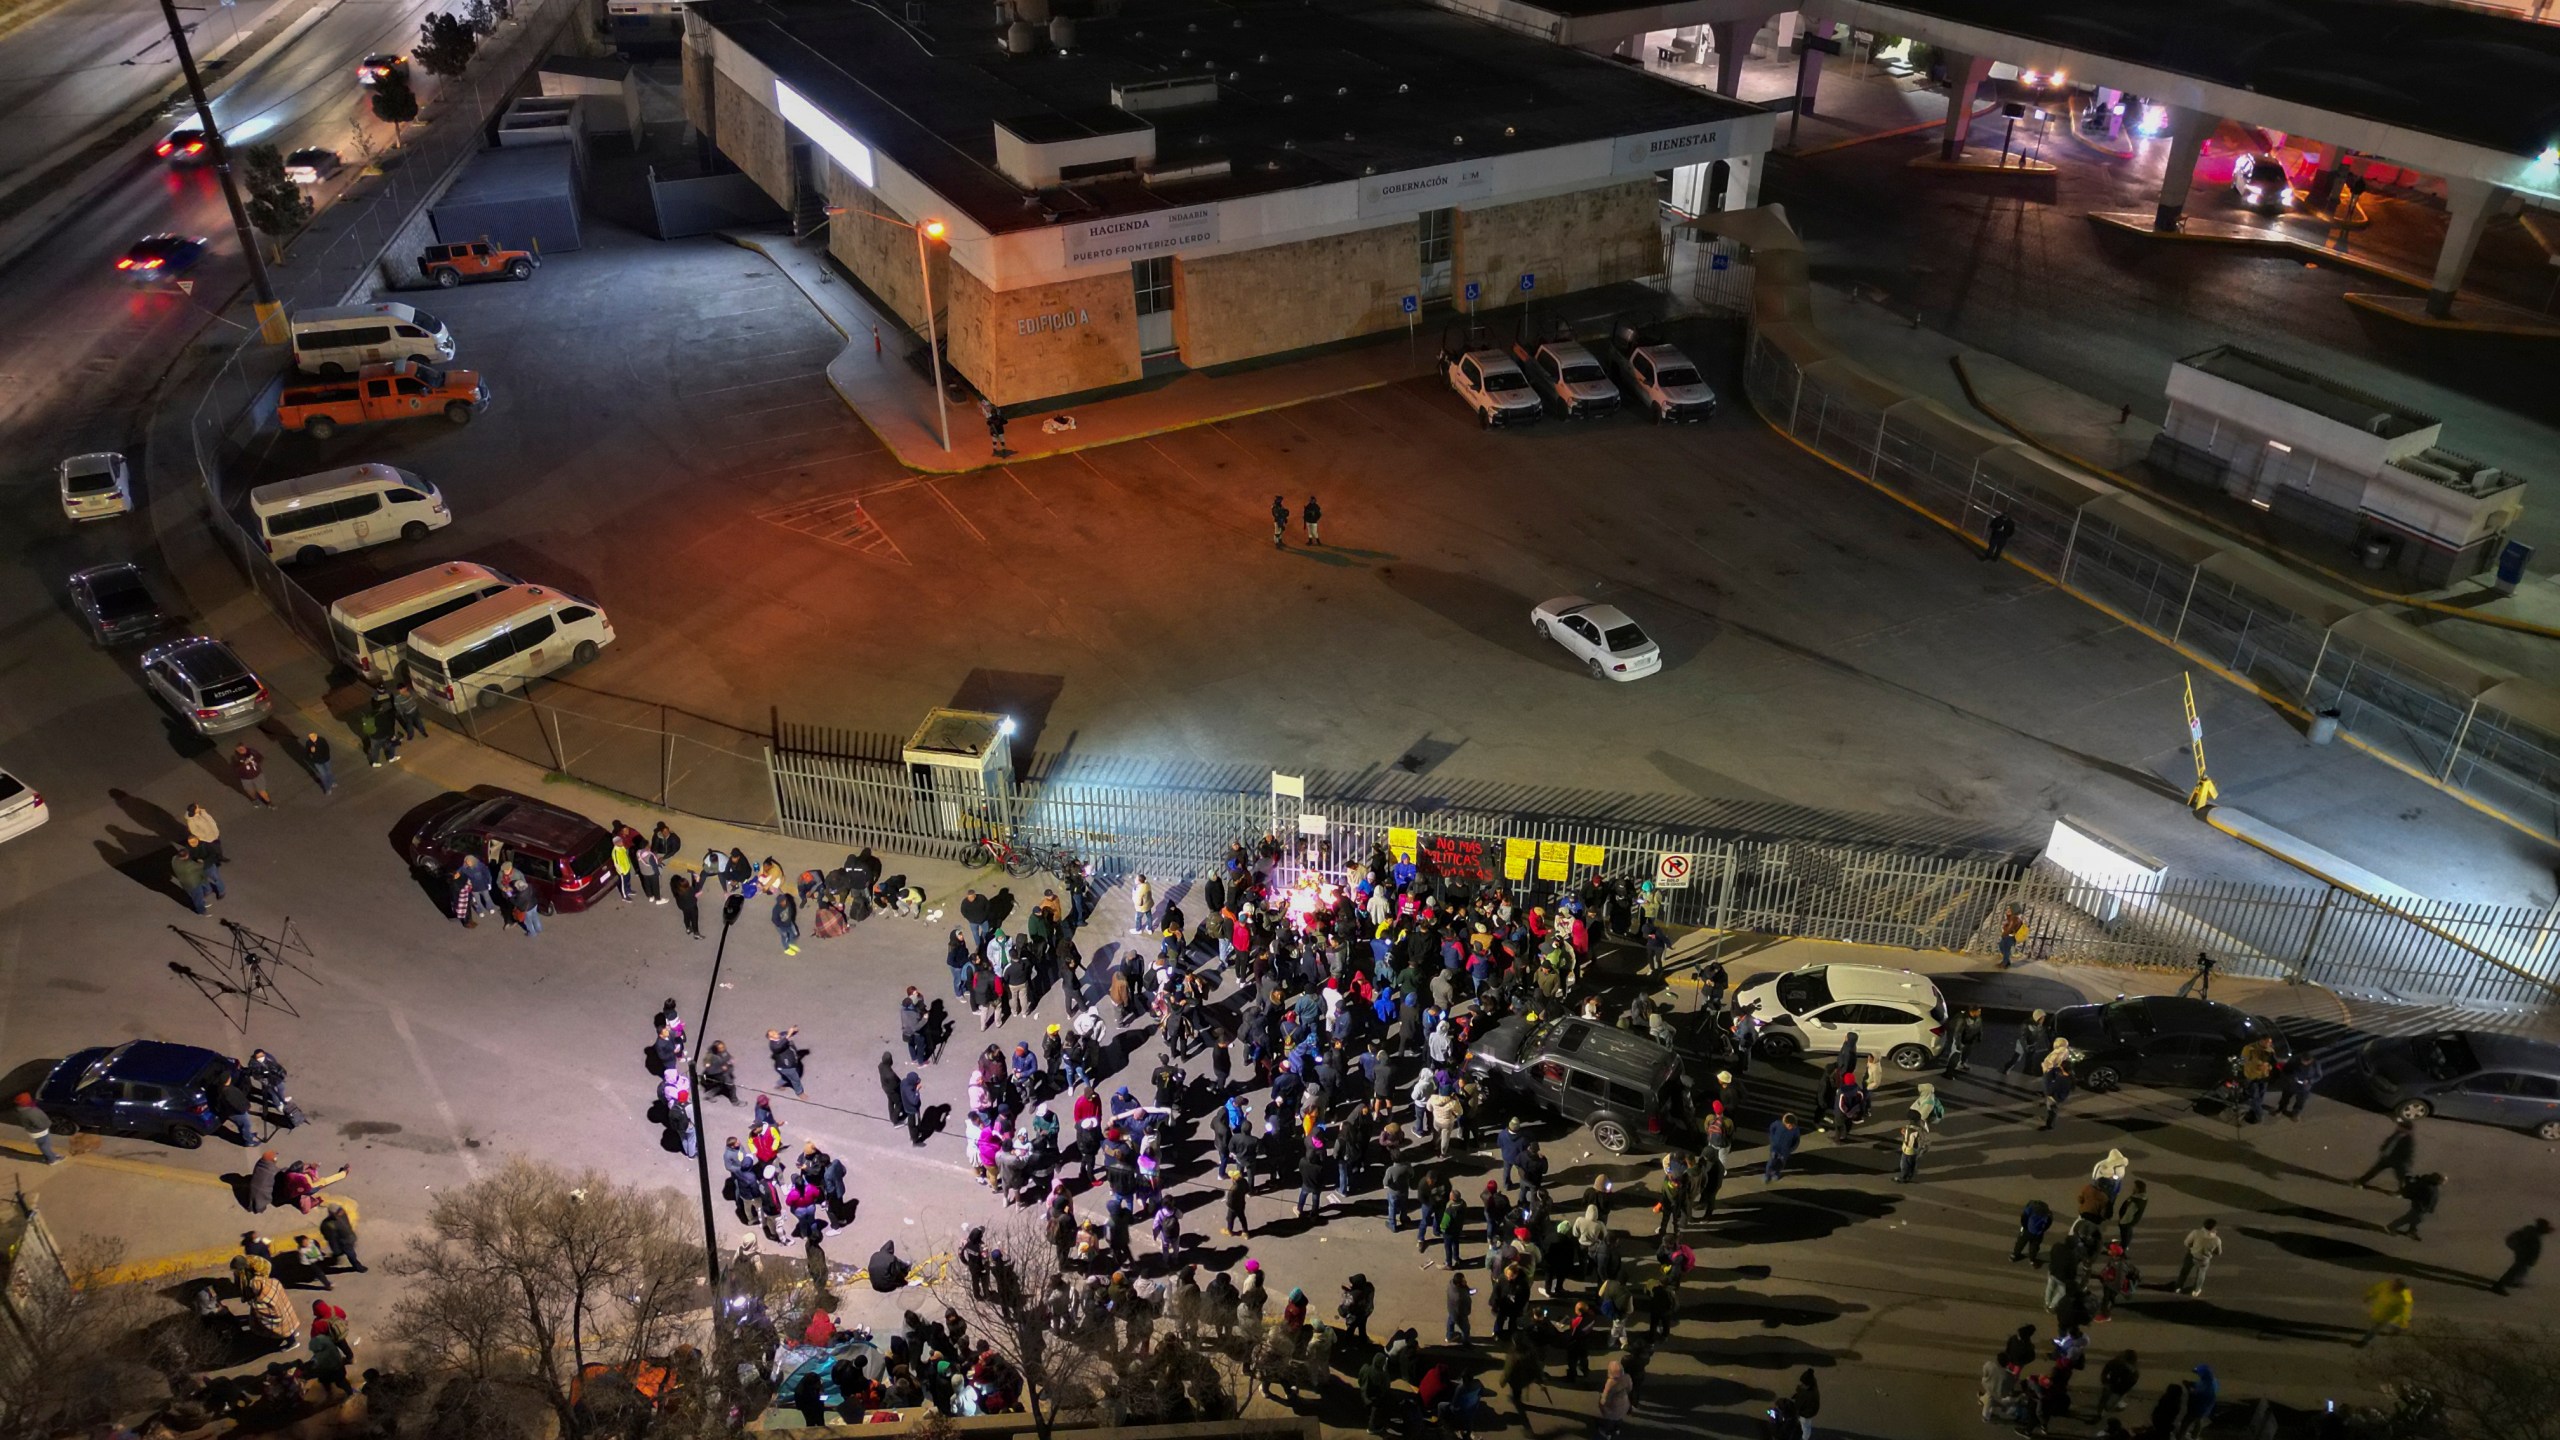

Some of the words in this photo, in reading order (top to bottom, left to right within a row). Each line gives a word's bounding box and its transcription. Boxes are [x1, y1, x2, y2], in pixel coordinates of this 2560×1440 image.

[1650, 132, 1716, 152] BIENESTAR
[1382, 176, 1448, 195] GOBERNACIÓN
[1168, 210, 1208, 223] INDAABIN
[1089, 219, 1150, 237] HACIENDA
[1073, 248, 1112, 262] PUERTO
[1115, 237, 1177, 255] FRONTERIZO
[1179, 232, 1211, 245] LERDO
[1017, 311, 1076, 335] EDIFICIO
[1080, 308, 1089, 325] A
[213, 685, 248, 699] ktsm.com
[1436, 837, 1455, 852] NO
[1459, 840, 1483, 855] MÁS
